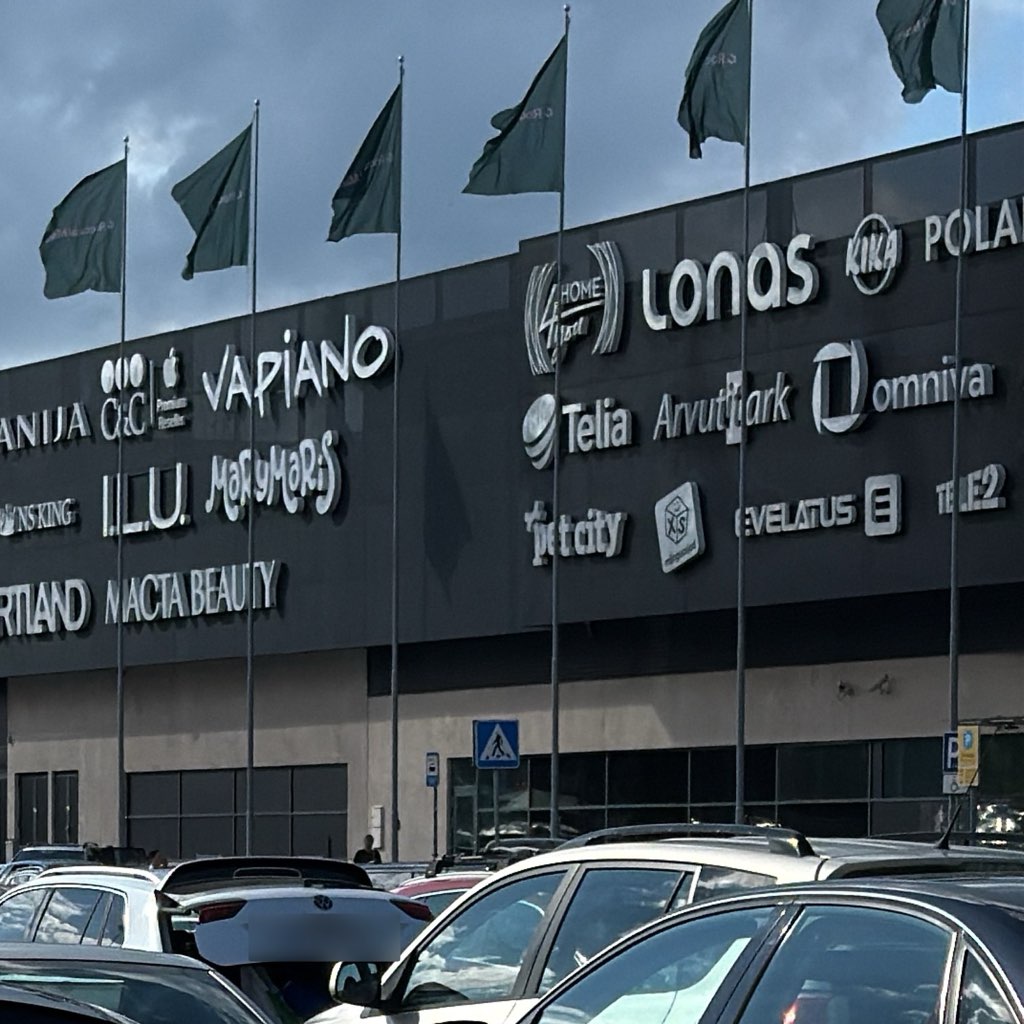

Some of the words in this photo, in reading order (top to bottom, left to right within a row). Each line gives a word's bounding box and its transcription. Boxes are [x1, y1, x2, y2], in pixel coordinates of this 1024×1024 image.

[926, 194, 1024, 262] POLA
[846, 229, 897, 276] KIKA
[561, 277, 602, 303] HOME
[872, 355, 987, 413] omniva
[562, 398, 629, 453] Telia
[36, 498, 73, 529] KING
[666, 516, 687, 537] XS
[735, 494, 856, 537] EVELATUS
[190, 560, 276, 616] BEAUTY
